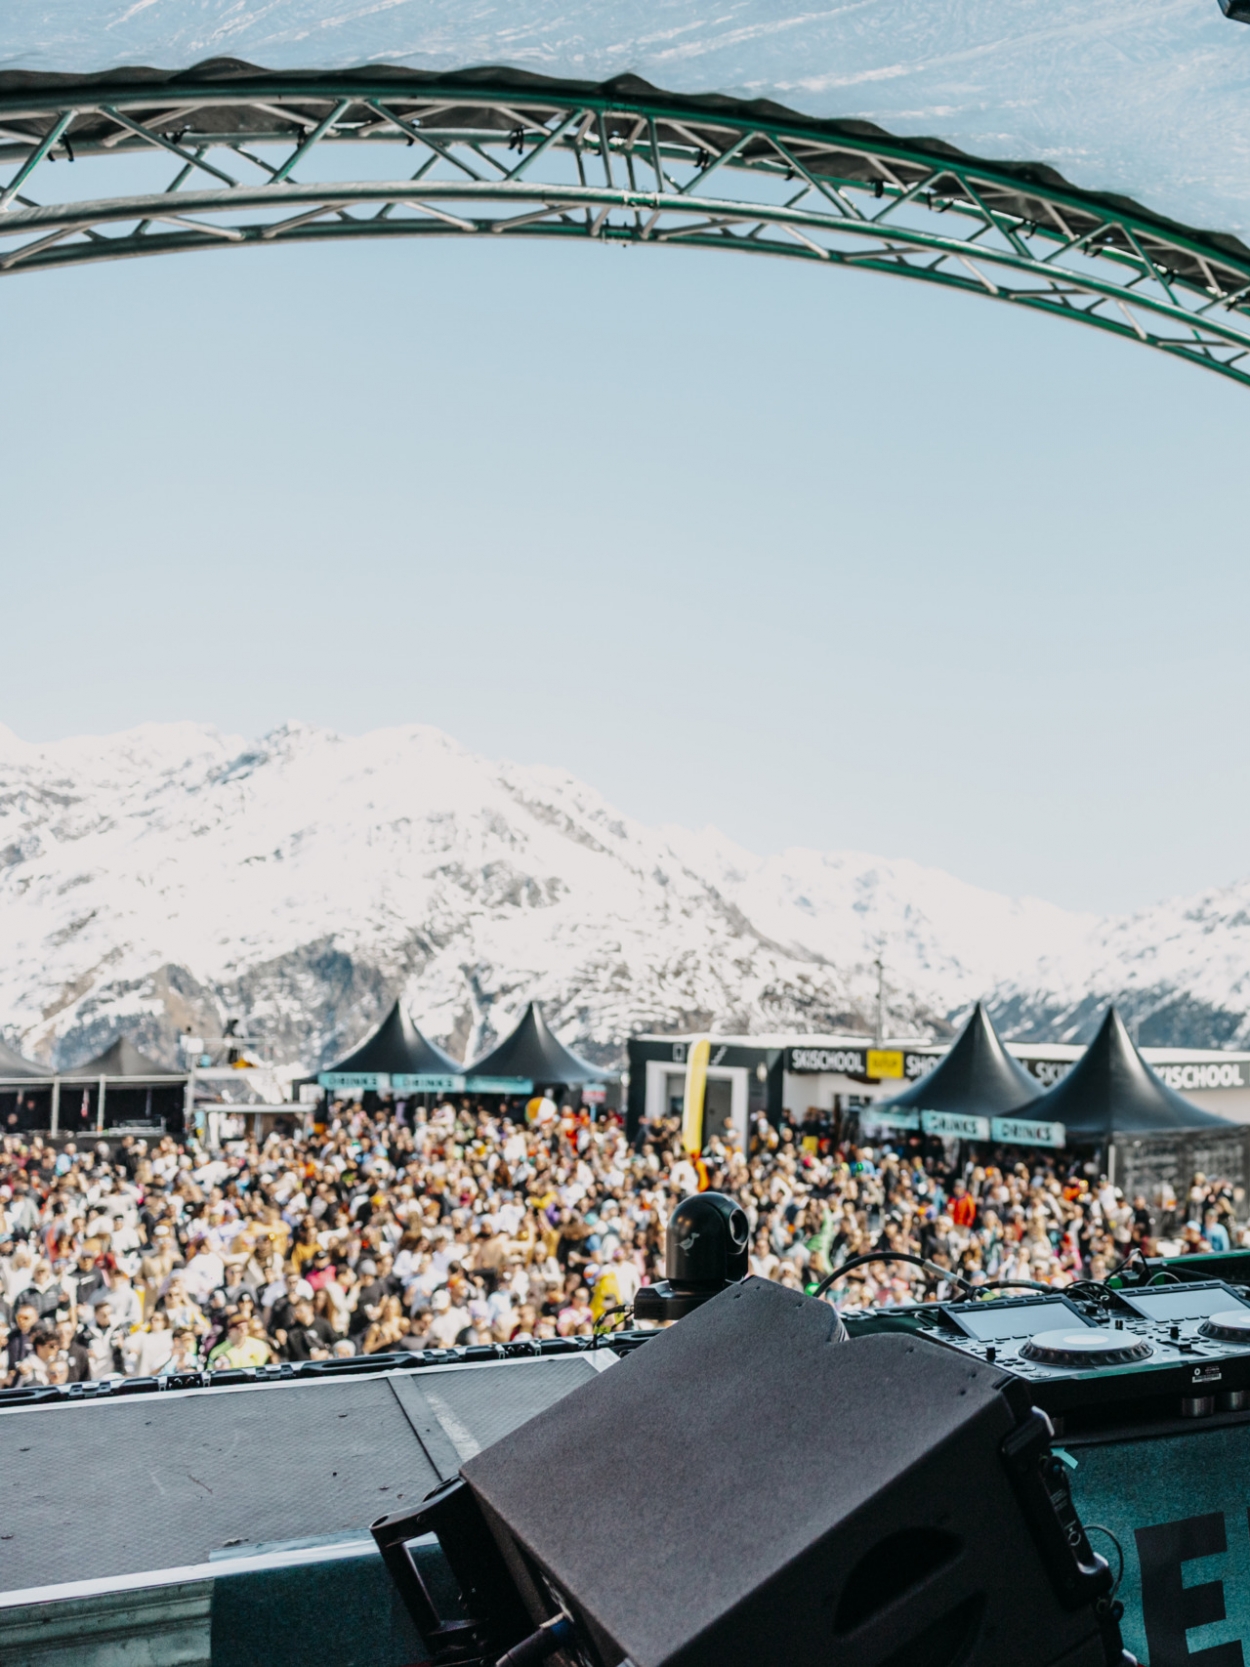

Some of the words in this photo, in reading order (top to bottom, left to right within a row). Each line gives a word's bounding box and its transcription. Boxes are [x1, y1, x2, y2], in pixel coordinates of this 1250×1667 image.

[792, 1049, 866, 1073] SKISCHOOL
[905, 1054, 941, 1077] SHO
[1154, 1064, 1244, 1089] KISCHOOL
[930, 1114, 978, 1135] DRINKS
[1001, 1123, 1051, 1142] DRINKS
